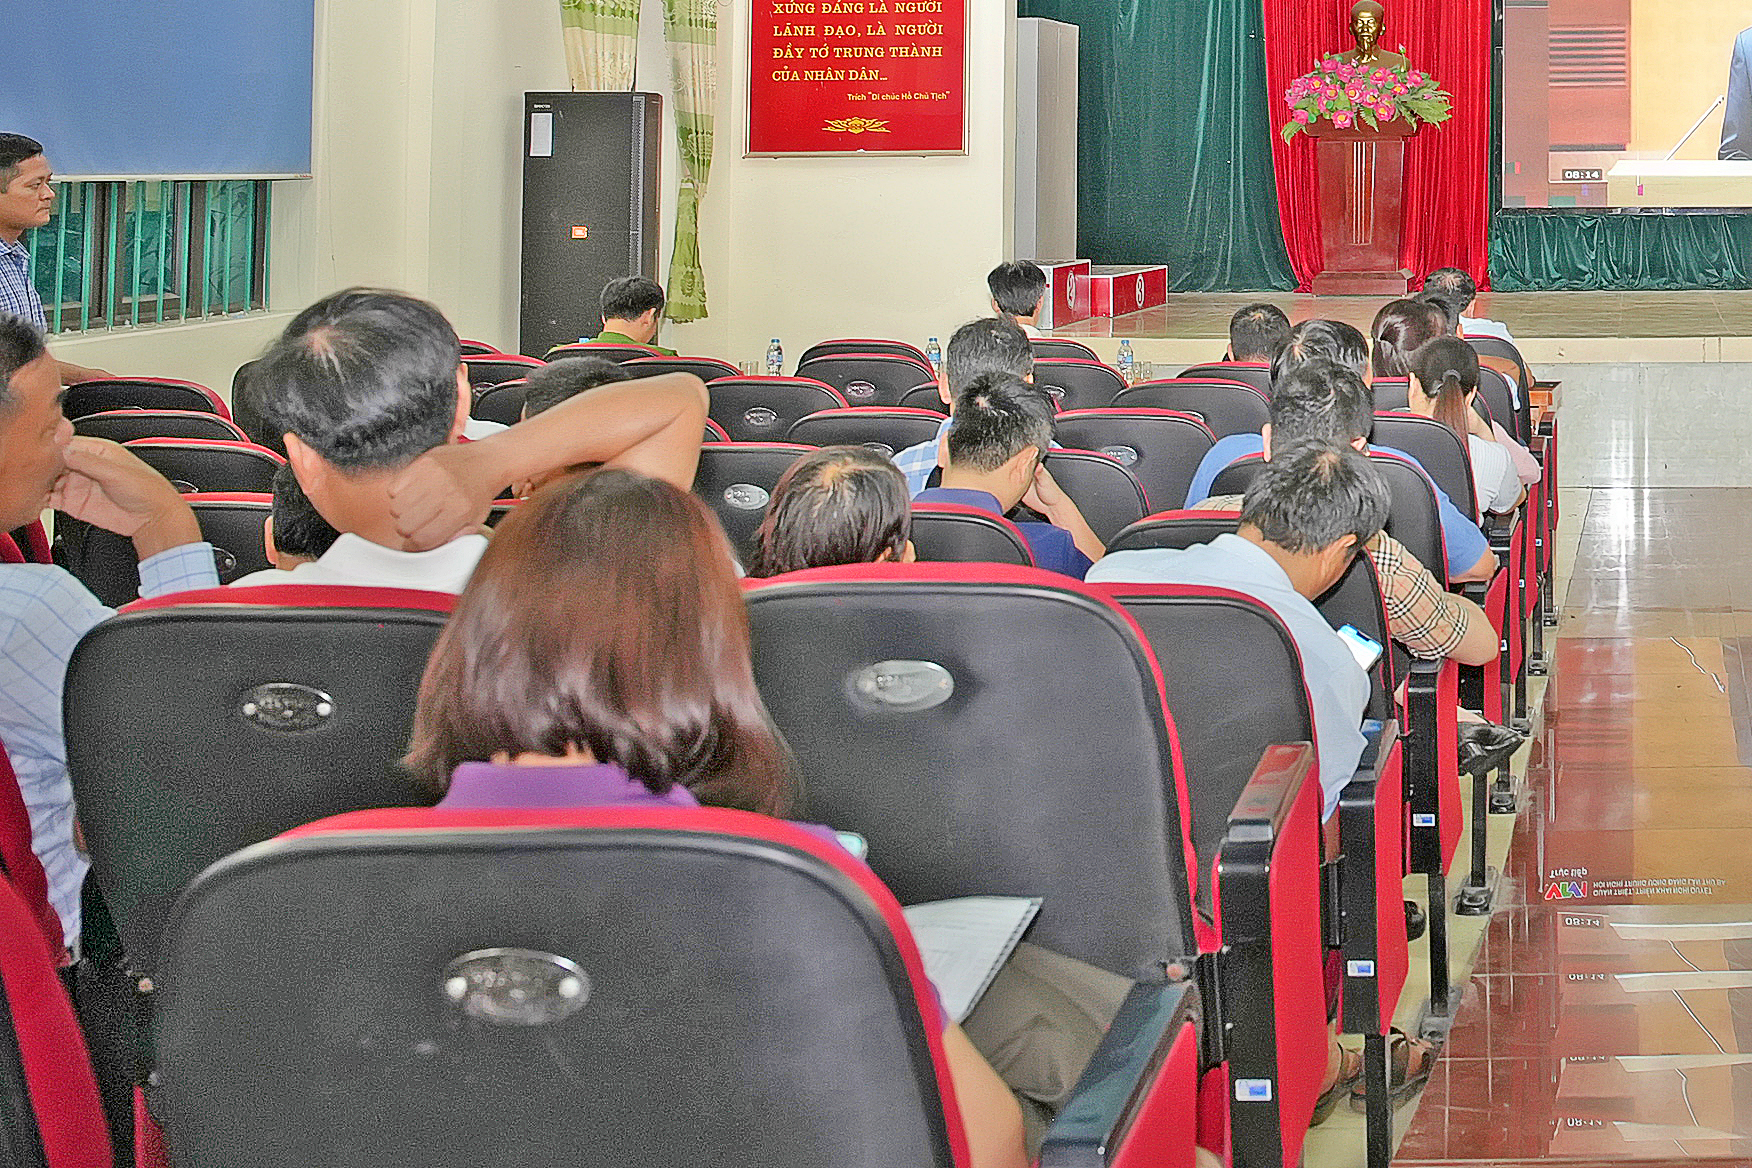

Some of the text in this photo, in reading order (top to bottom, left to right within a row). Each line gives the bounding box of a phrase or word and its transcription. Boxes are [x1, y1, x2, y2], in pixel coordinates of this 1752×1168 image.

[773, 0, 815, 14] XỨNG
[821, 0, 864, 13] ĐÁNG
[869, 0, 888, 13] LÀ
[773, 20, 943, 38] LÃNH ĐẠO, LÀ NGƯỜI
[773, 43, 943, 58] ĐẦY TỚ TRUNG THÀNH
[772, 66, 800, 81] CỦA
[804, 68, 845, 81] NHÂN
[1565, 171, 1599, 179] 08:14
